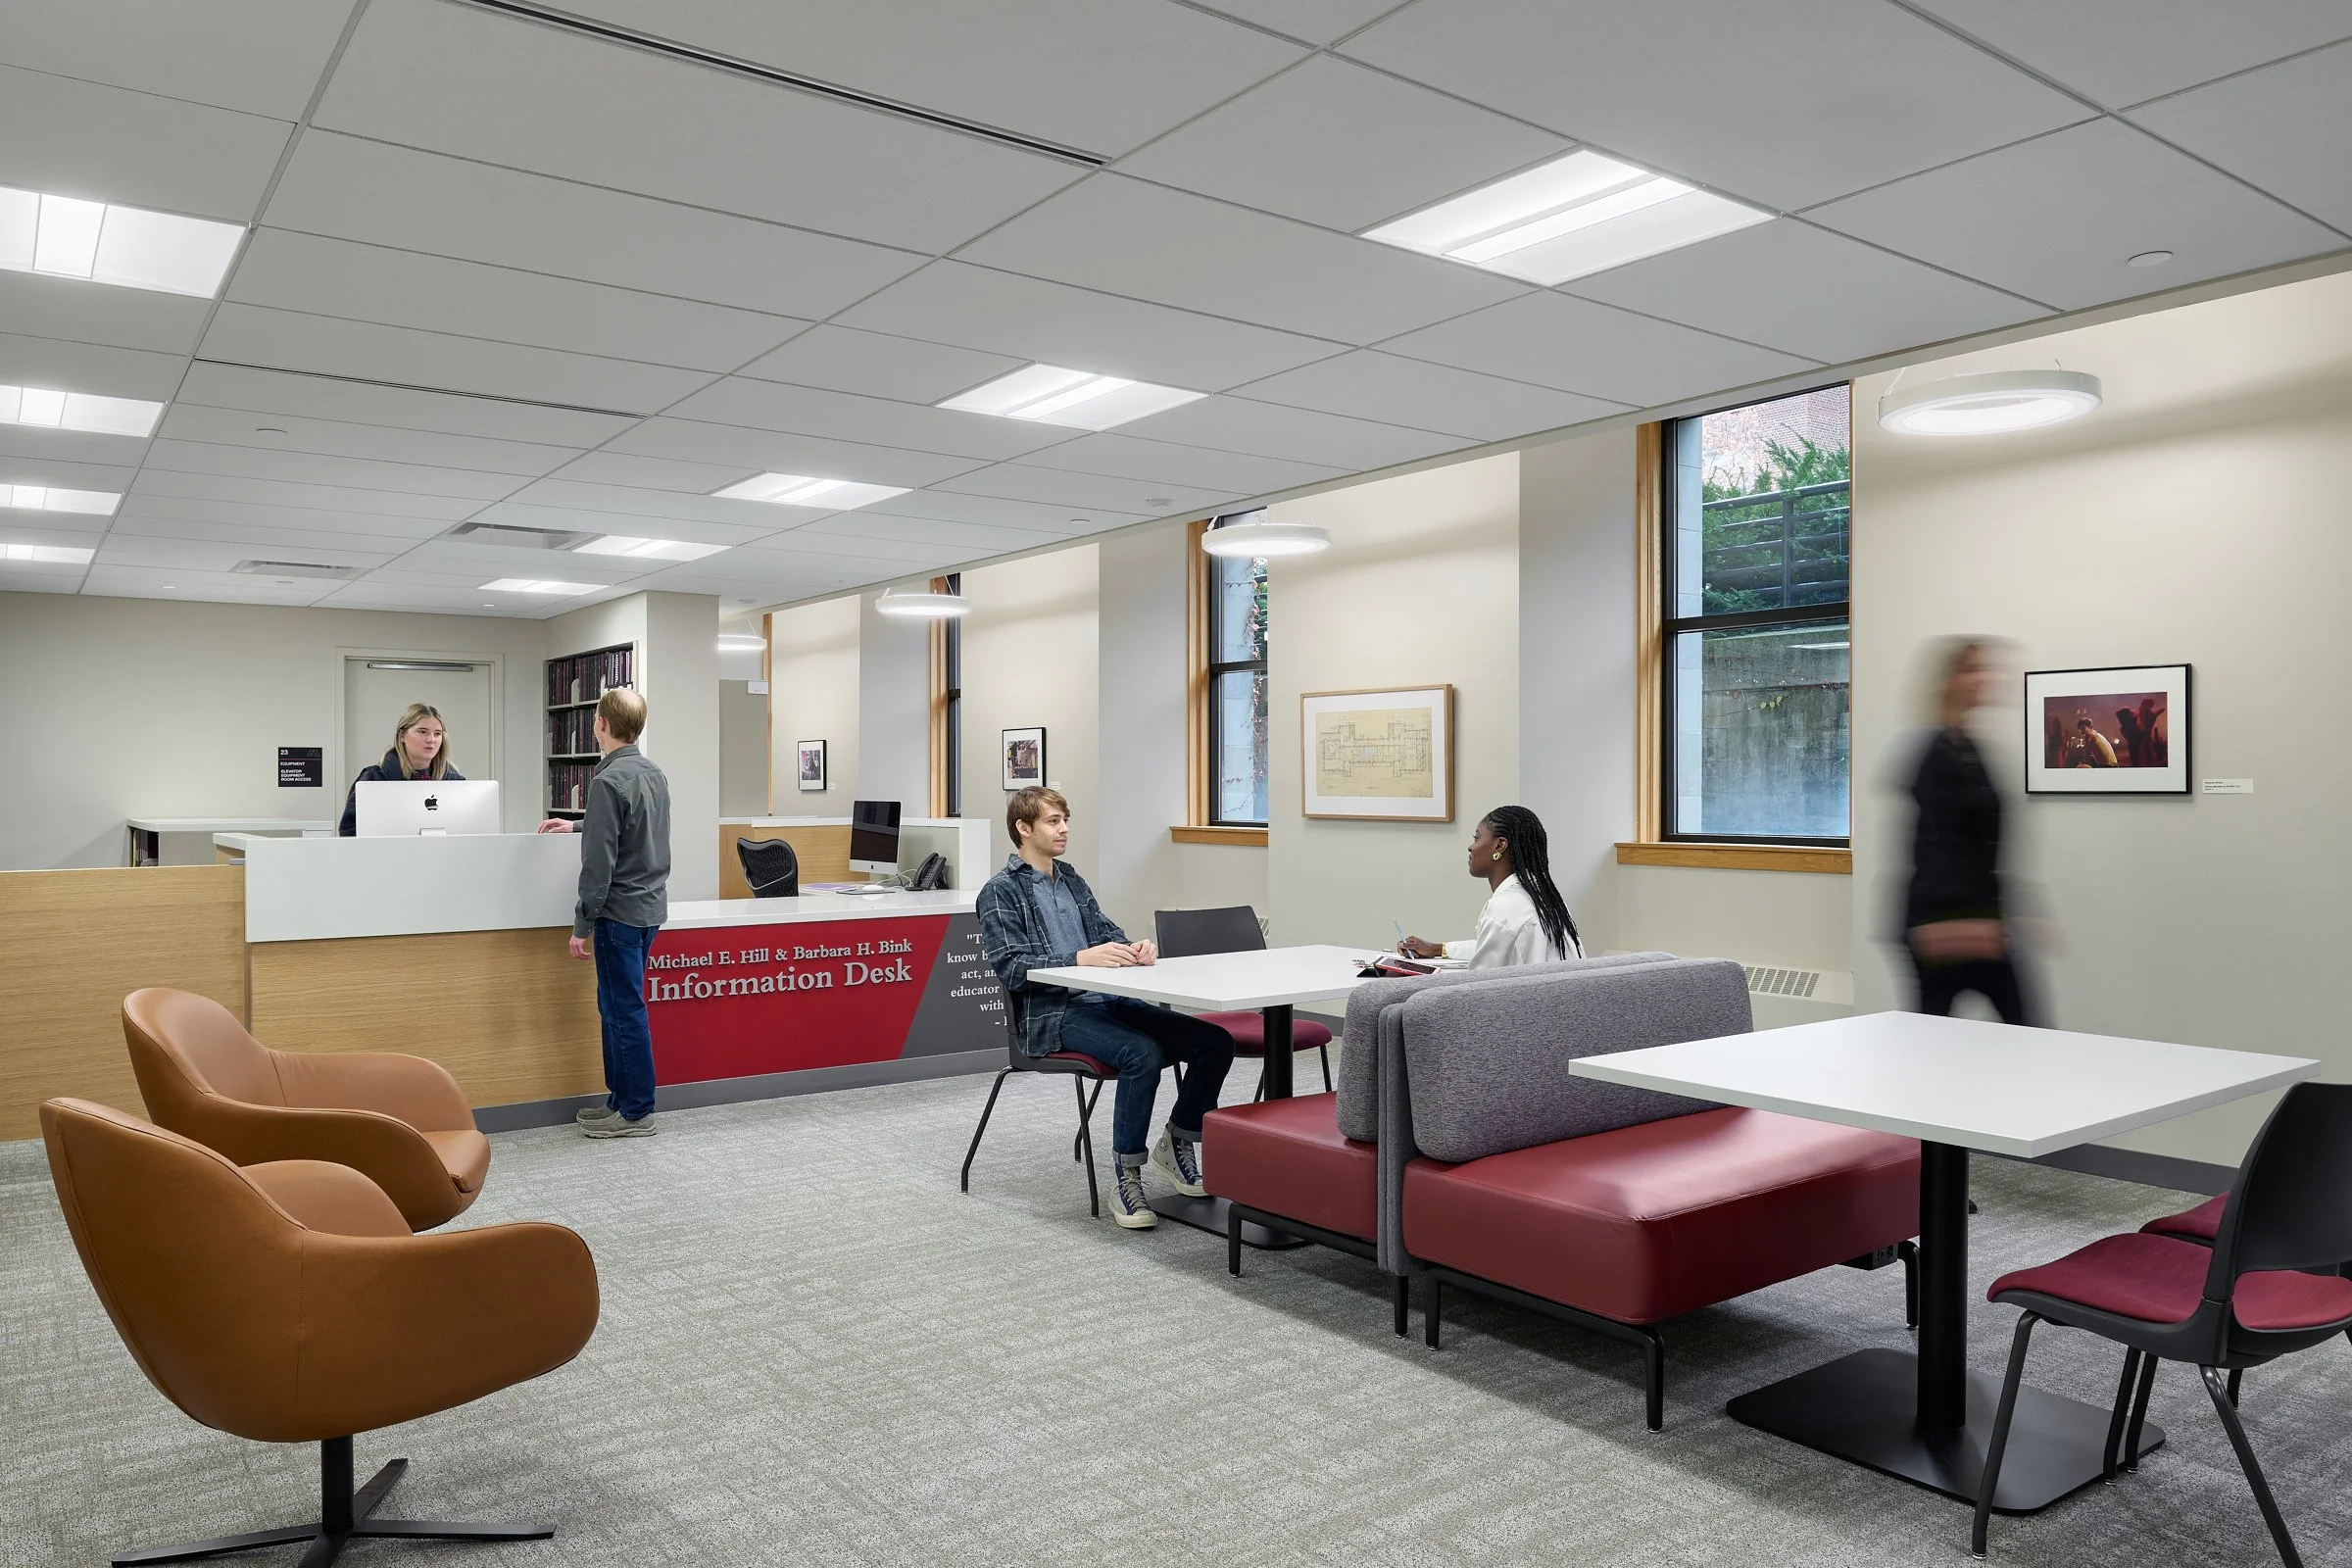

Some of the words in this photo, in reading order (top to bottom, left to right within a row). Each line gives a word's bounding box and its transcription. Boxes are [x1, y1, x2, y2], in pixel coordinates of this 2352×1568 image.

[966, 933, 985, 945] "T
[648, 952, 713, 970] Michael
[718, 951, 736, 965] E.
[740, 948, 769, 964] Hill
[775, 949, 788, 961] &
[793, 944, 852, 960] Barbara
[857, 942, 875, 956] H.
[878, 938, 912, 955] Bink
[947, 952, 978, 963] know
[981, 950, 989, 960] b
[648, 965, 834, 1003] Information
[844, 957, 912, 987] Desk
[960, 969, 982, 980] act,
[951, 985, 1001, 998] educator
[980, 999, 1004, 1011] with
